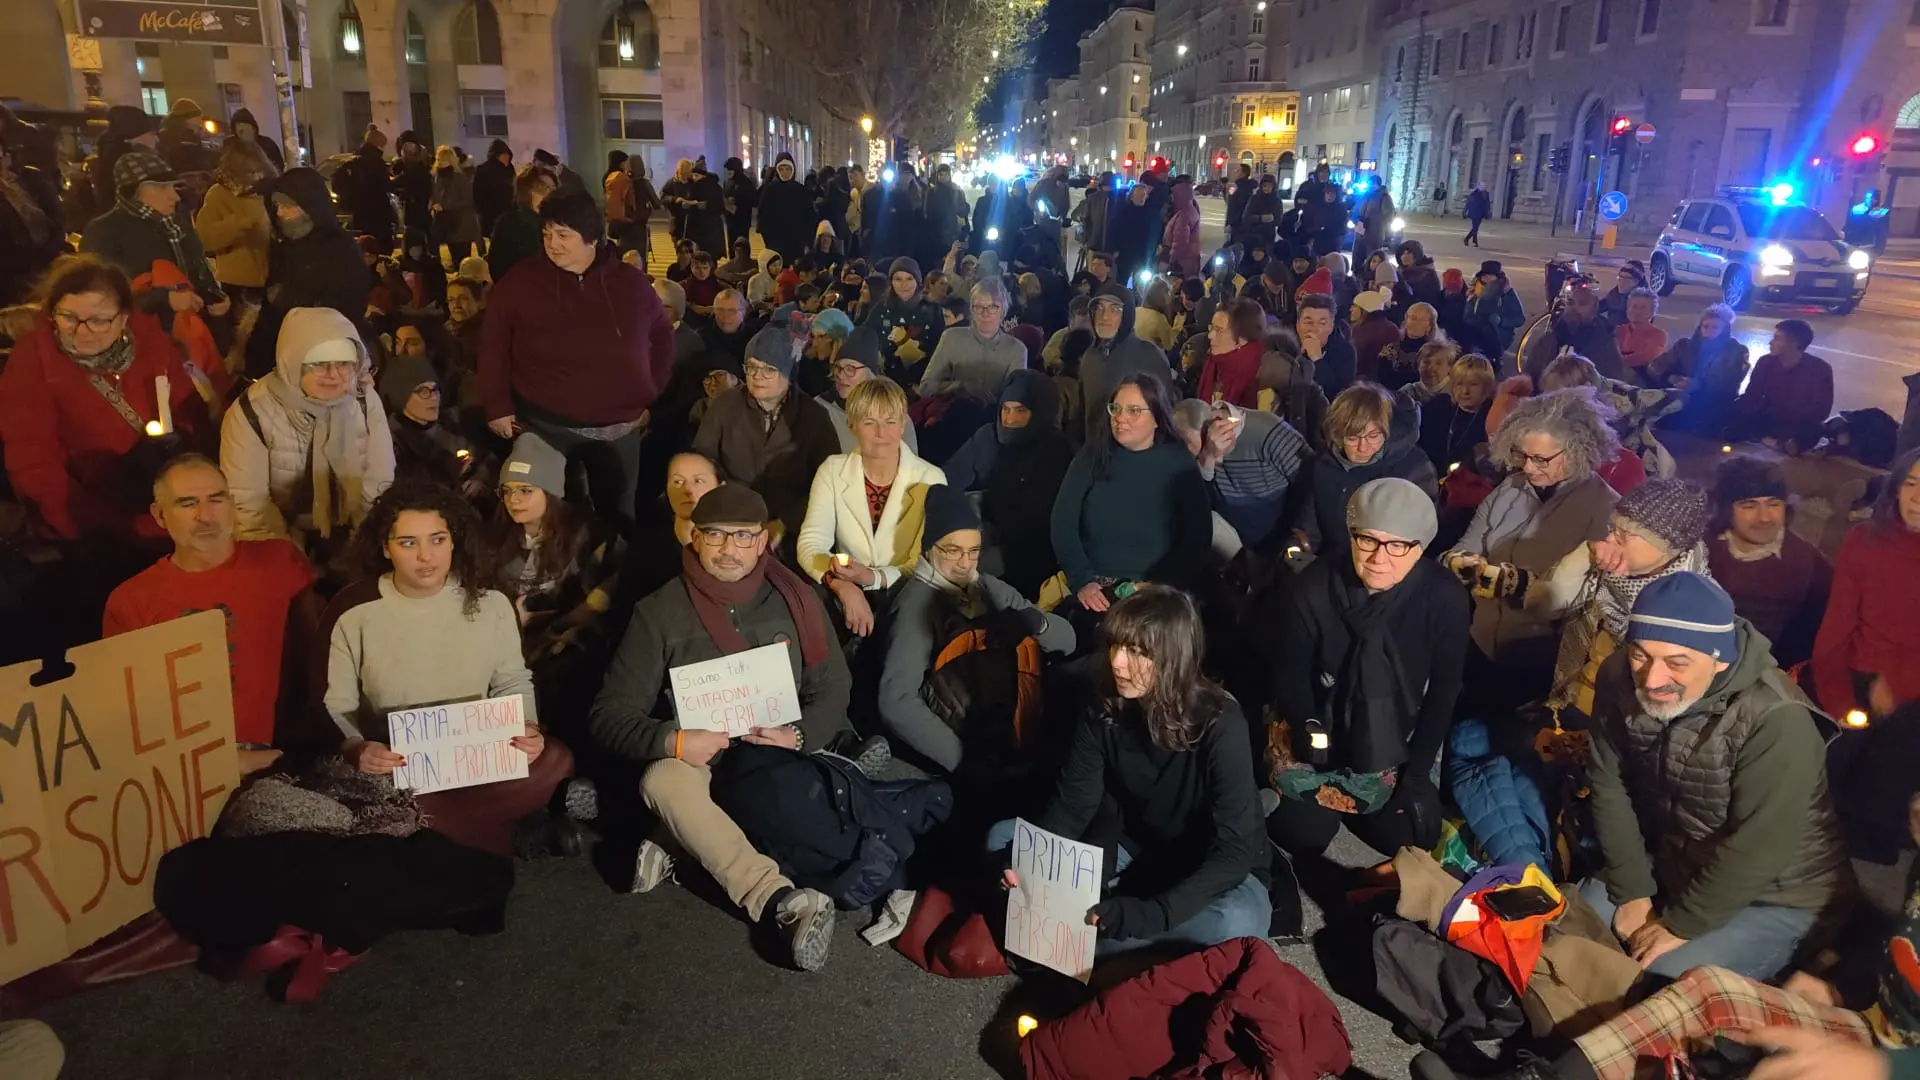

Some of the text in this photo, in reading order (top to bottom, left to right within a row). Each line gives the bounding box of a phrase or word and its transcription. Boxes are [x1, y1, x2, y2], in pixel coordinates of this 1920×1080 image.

[124, 642, 212, 755] LE
[676, 669, 721, 690] Siamo
[390, 708, 449, 747] PRIMA
[463, 698, 521, 734] PERSONE
[394, 749, 441, 788] NON
[455, 740, 518, 782] PROFITTO
[1017, 824, 1095, 893] PRIMA
[1007, 899, 1093, 976] PERSONE
